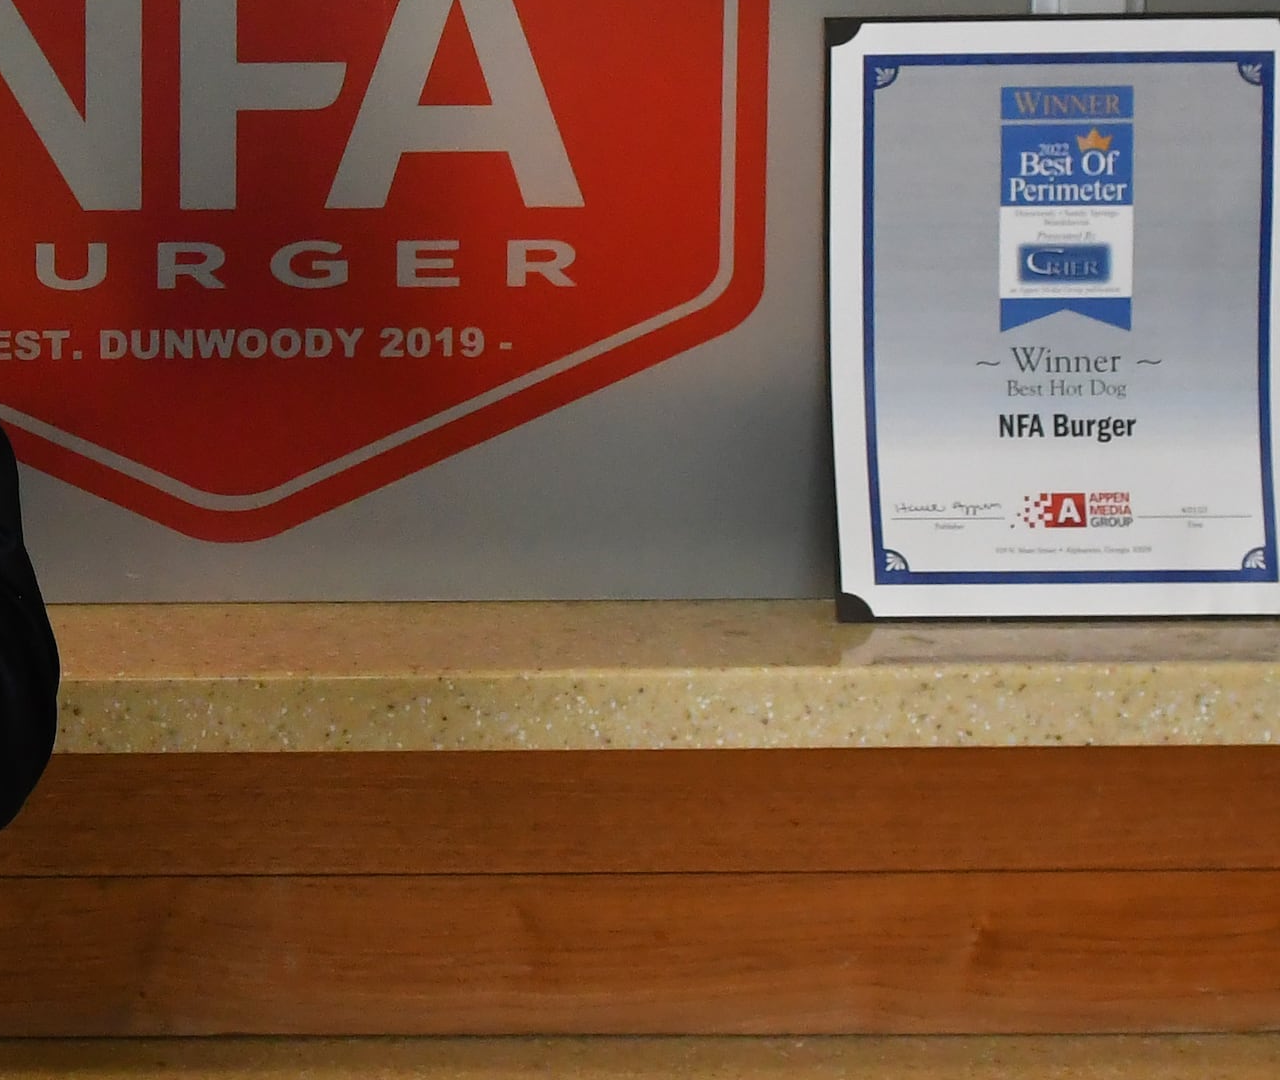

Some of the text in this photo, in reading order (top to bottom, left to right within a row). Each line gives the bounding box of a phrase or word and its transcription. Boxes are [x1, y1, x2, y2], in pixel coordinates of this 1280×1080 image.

[1014, 91, 1121, 115] WINNER
[1020, 150, 1121, 177] Best Of
[1008, 176, 1127, 203] Perimeter
[100, 328, 364, 360] DUNWOODY
[380, 327, 486, 358] 2019
[1010, 346, 1122, 373] Winner
[1007, 379, 1128, 400] Best Hot Dog
[999, 413, 1137, 443] NFA Burger
[1090, 492, 1130, 503] APPEN
[1090, 504, 1132, 516] MEDIA
[1090, 516, 1134, 528] GROUP
